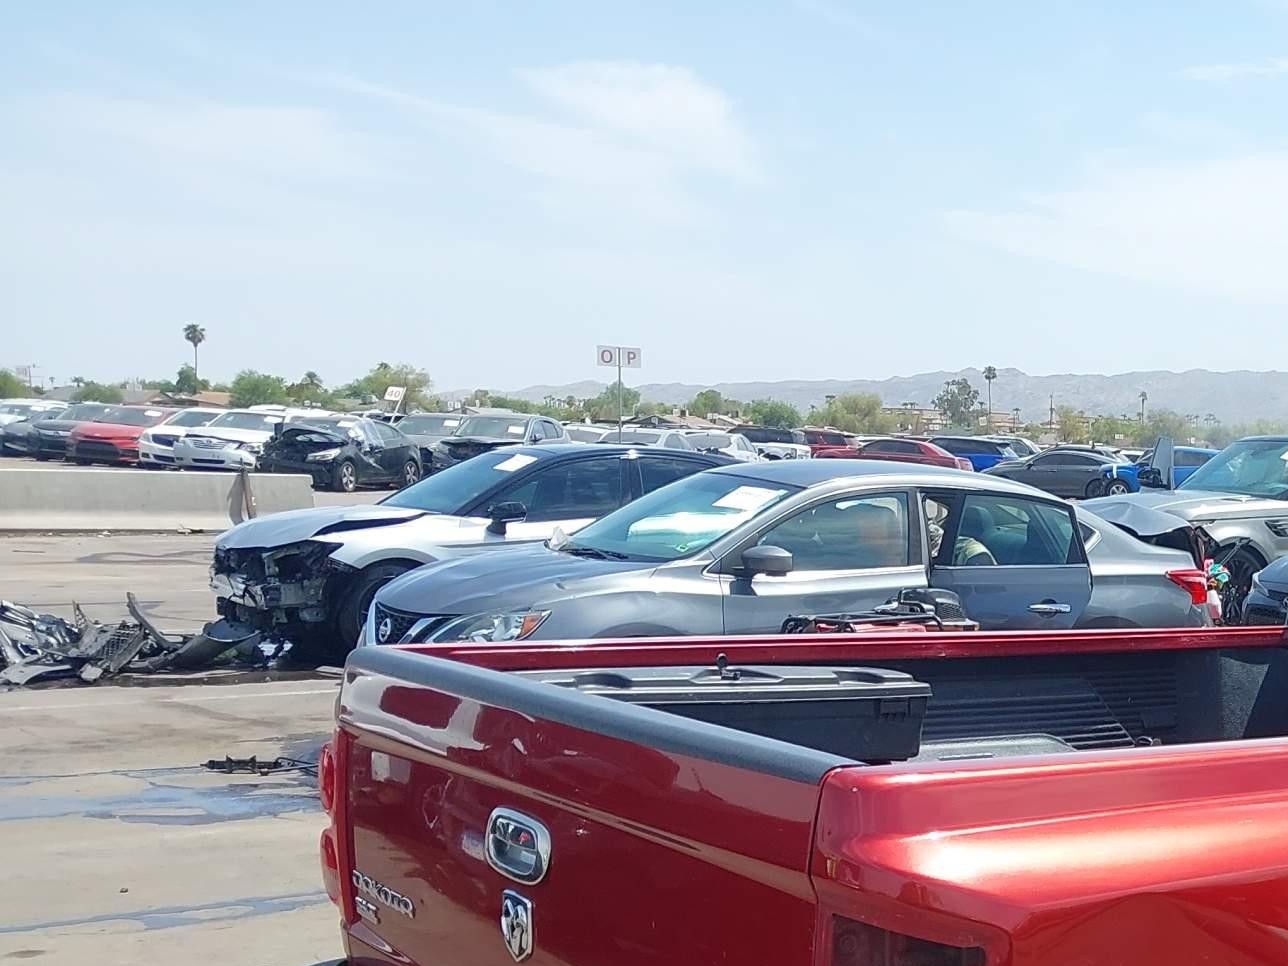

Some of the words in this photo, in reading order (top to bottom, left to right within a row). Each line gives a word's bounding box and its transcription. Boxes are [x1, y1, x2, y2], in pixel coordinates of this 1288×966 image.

[601, 349, 613, 364] O
[627, 351, 636, 365] P
[387, 390, 401, 398] 40
